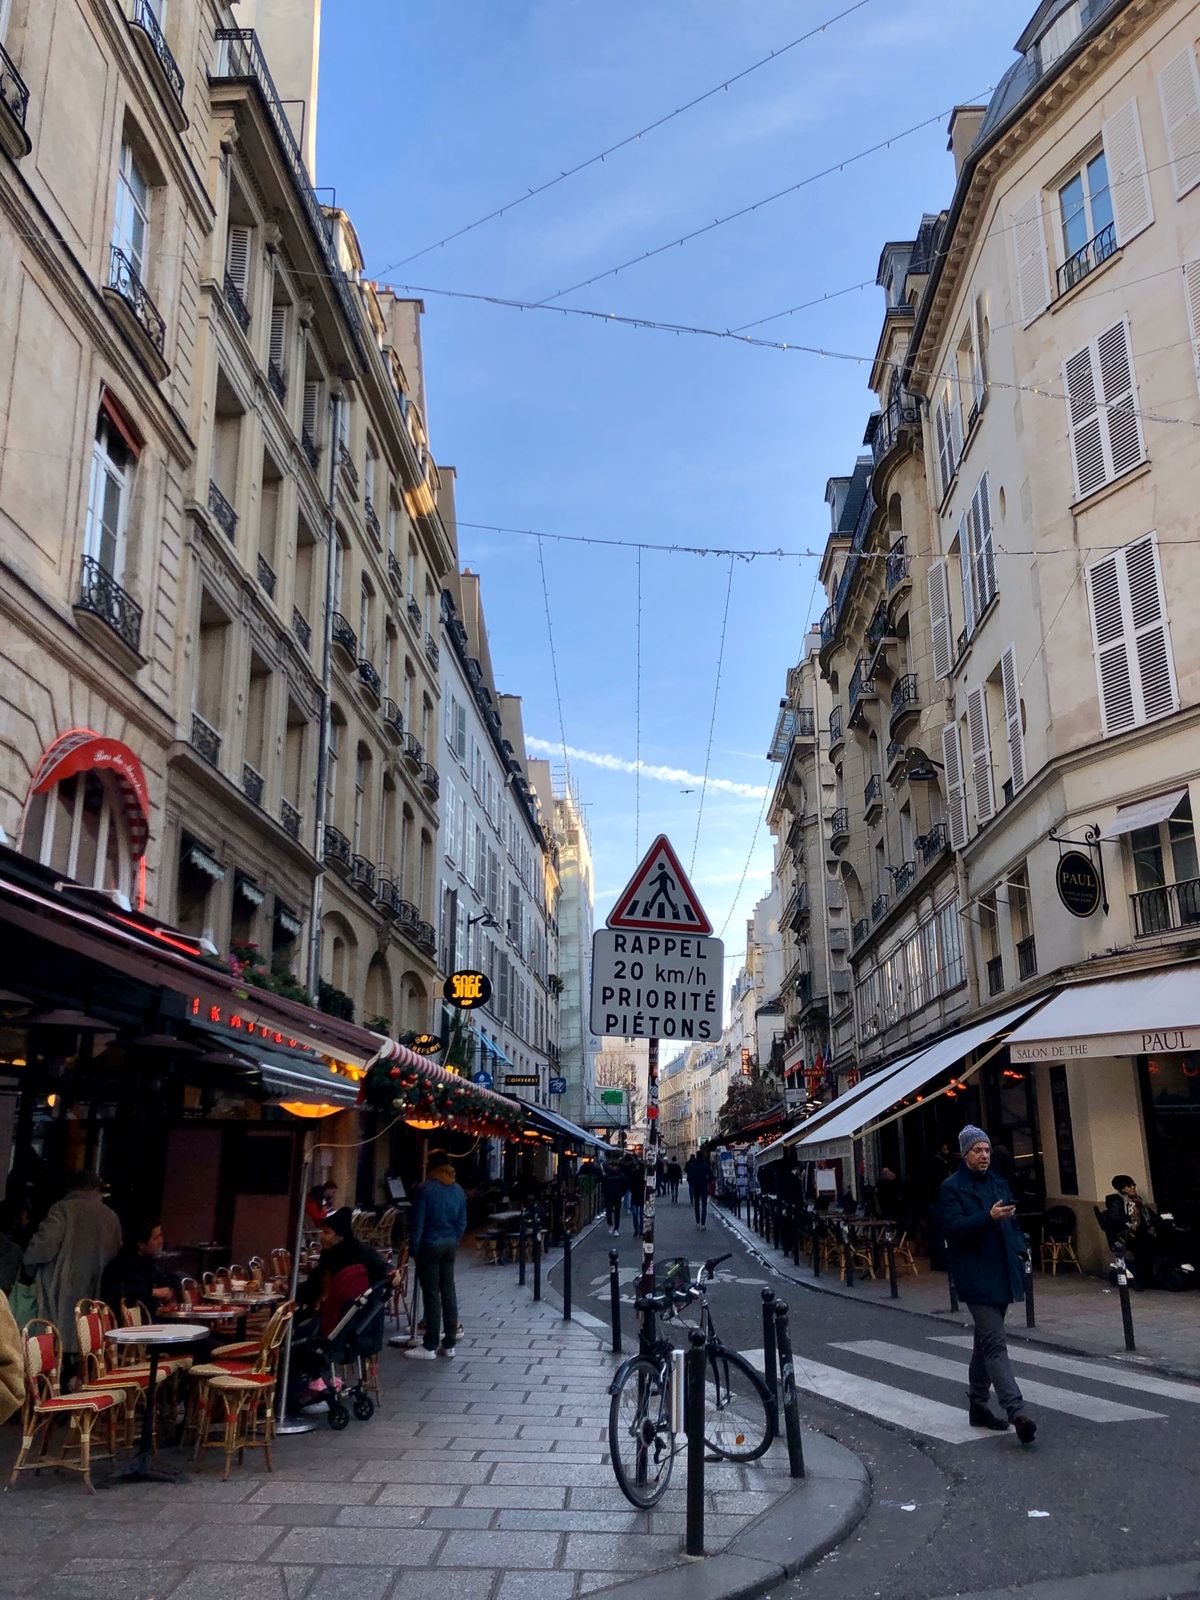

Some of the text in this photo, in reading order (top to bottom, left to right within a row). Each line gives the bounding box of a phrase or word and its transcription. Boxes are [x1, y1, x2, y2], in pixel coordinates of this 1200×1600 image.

[1062, 871, 1095, 887] PAUL
[614, 934, 707, 959] RAPPEL
[613, 961, 644, 980] 20
[655, 963, 707, 985] km/h
[602, 986, 716, 1012] PRIORITÉ
[605, 1011, 711, 1039] PIÉTONS
[1017, 1043, 1088, 1059] SALON DE THE
[1141, 1031, 1192, 1052] PAUL
